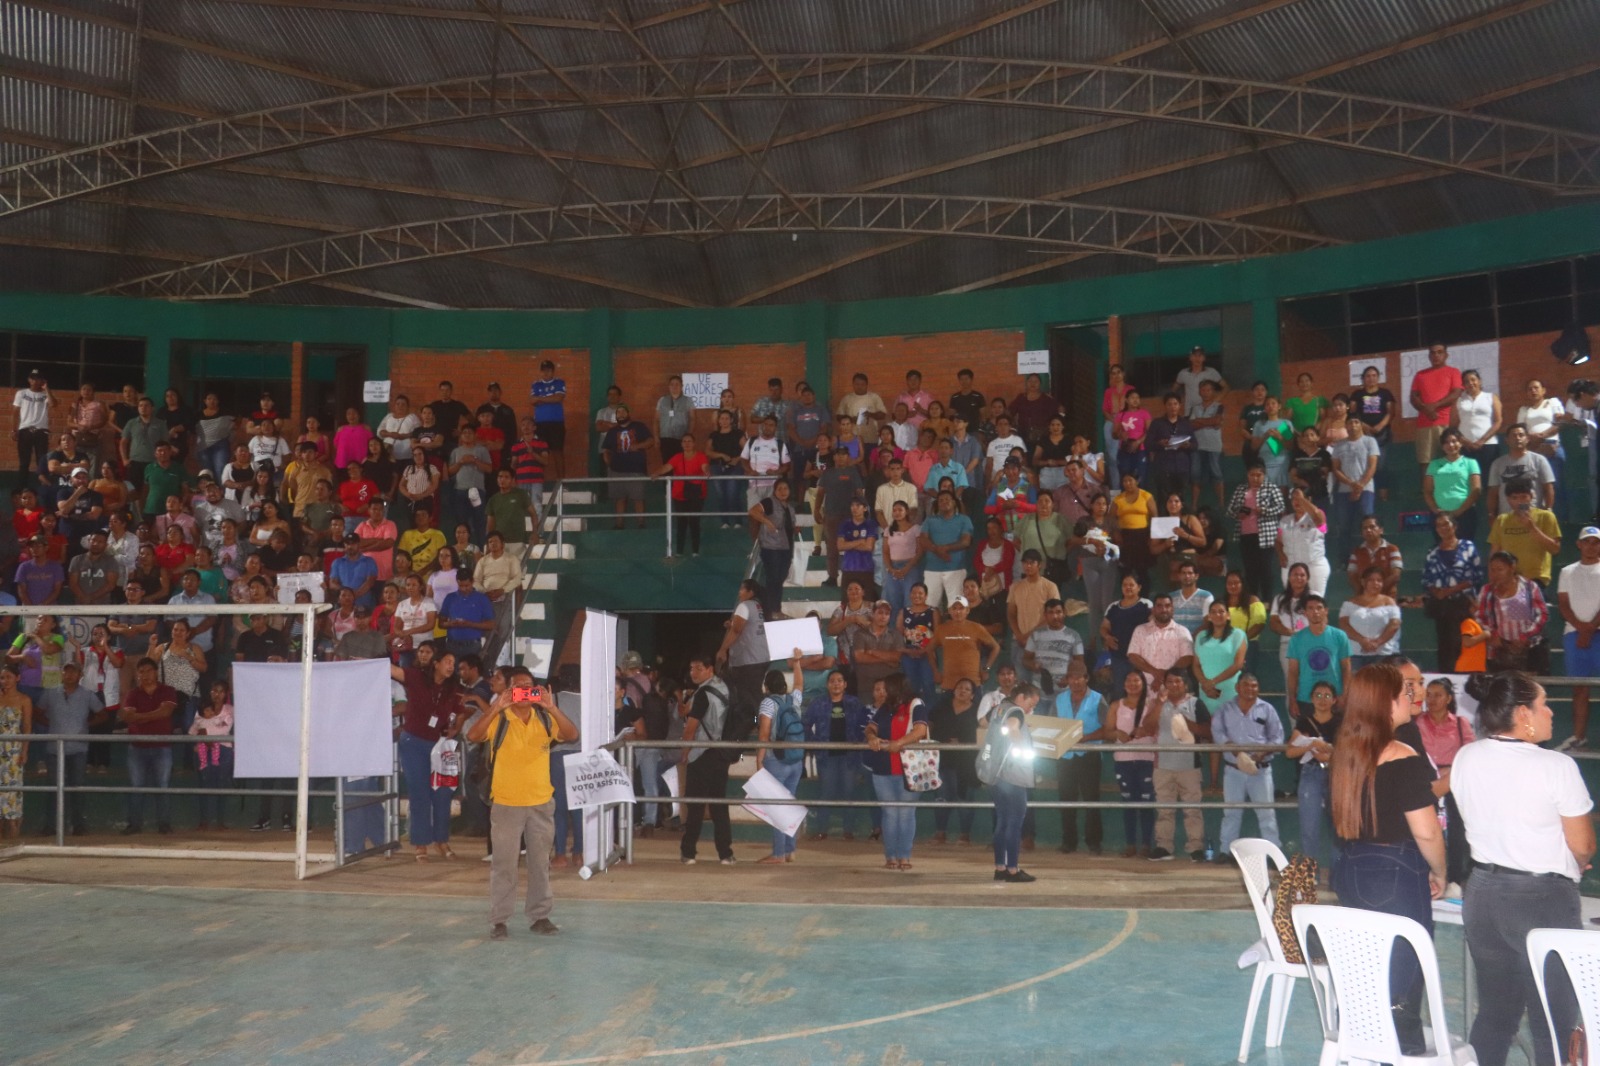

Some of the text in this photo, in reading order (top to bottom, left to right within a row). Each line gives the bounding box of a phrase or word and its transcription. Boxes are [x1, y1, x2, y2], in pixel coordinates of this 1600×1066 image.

[684, 382, 723, 395] ANDRES
[690, 396, 721, 407] BELLO
[576, 771, 603, 782] LUGAR
[572, 779, 630, 792] VOTO ASISTIDO
